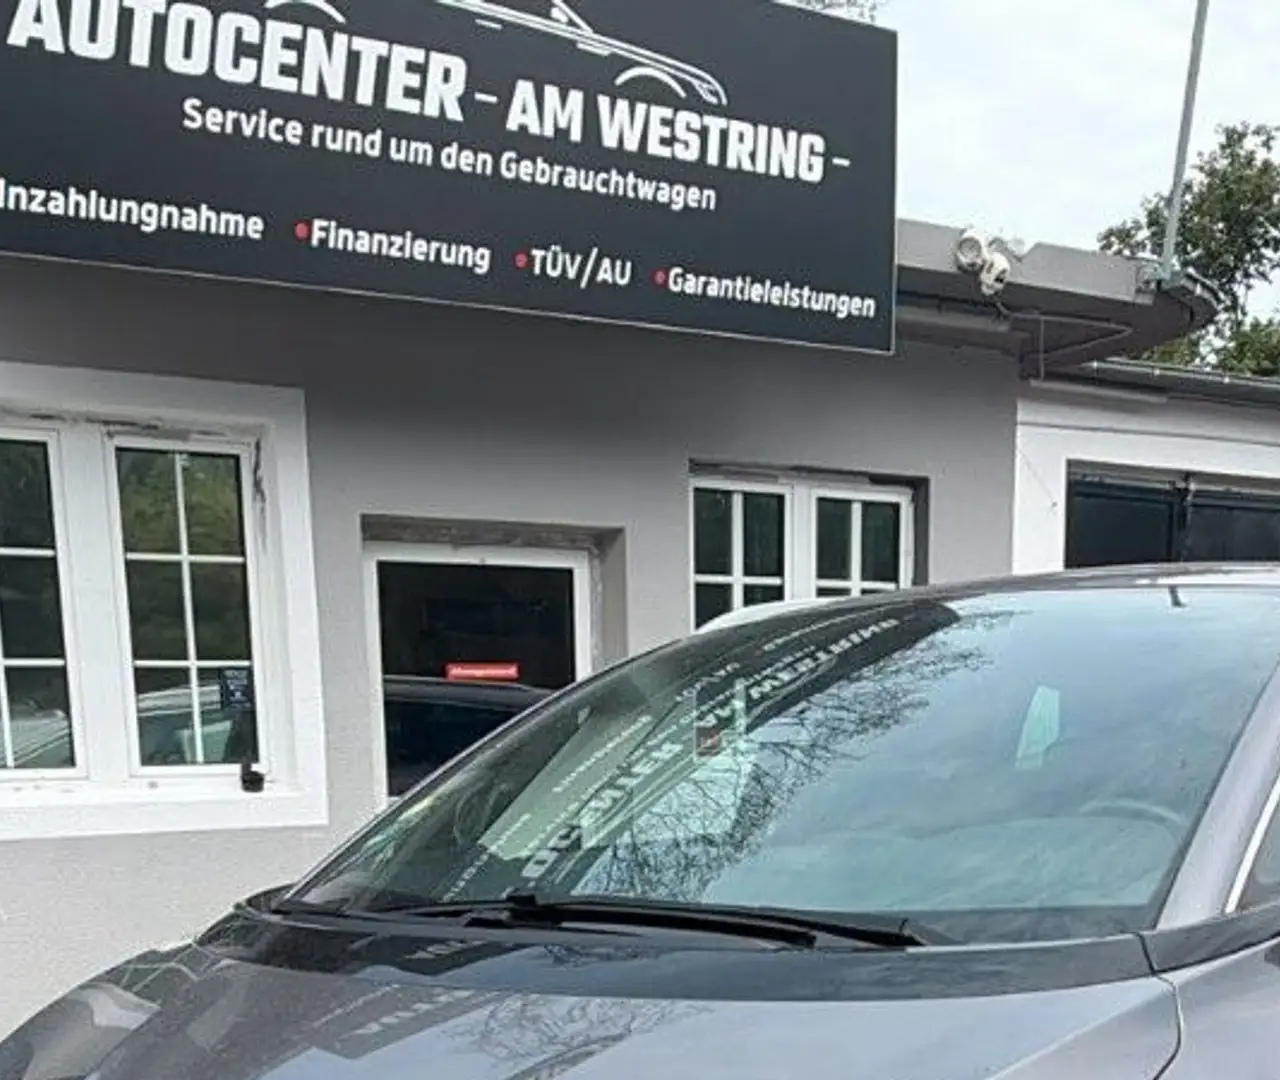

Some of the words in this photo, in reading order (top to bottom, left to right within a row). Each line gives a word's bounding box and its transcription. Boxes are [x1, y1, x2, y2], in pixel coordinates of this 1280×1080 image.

[7, 0, 468, 122] AUTOCENTER
[505, 78, 583, 143] AM
[598, 93, 826, 183] WESTRING
[182, 97, 302, 145] Service
[311, 126, 381, 158] rund
[390, 137, 432, 166] um
[441, 142, 493, 176] den
[500, 150, 717, 211] Gebrauchtwagen
[310, 218, 491, 275] Finanzierung
[531, 245, 633, 289] TÜV/AU
[668, 266, 876, 319] Garantieleistungen
